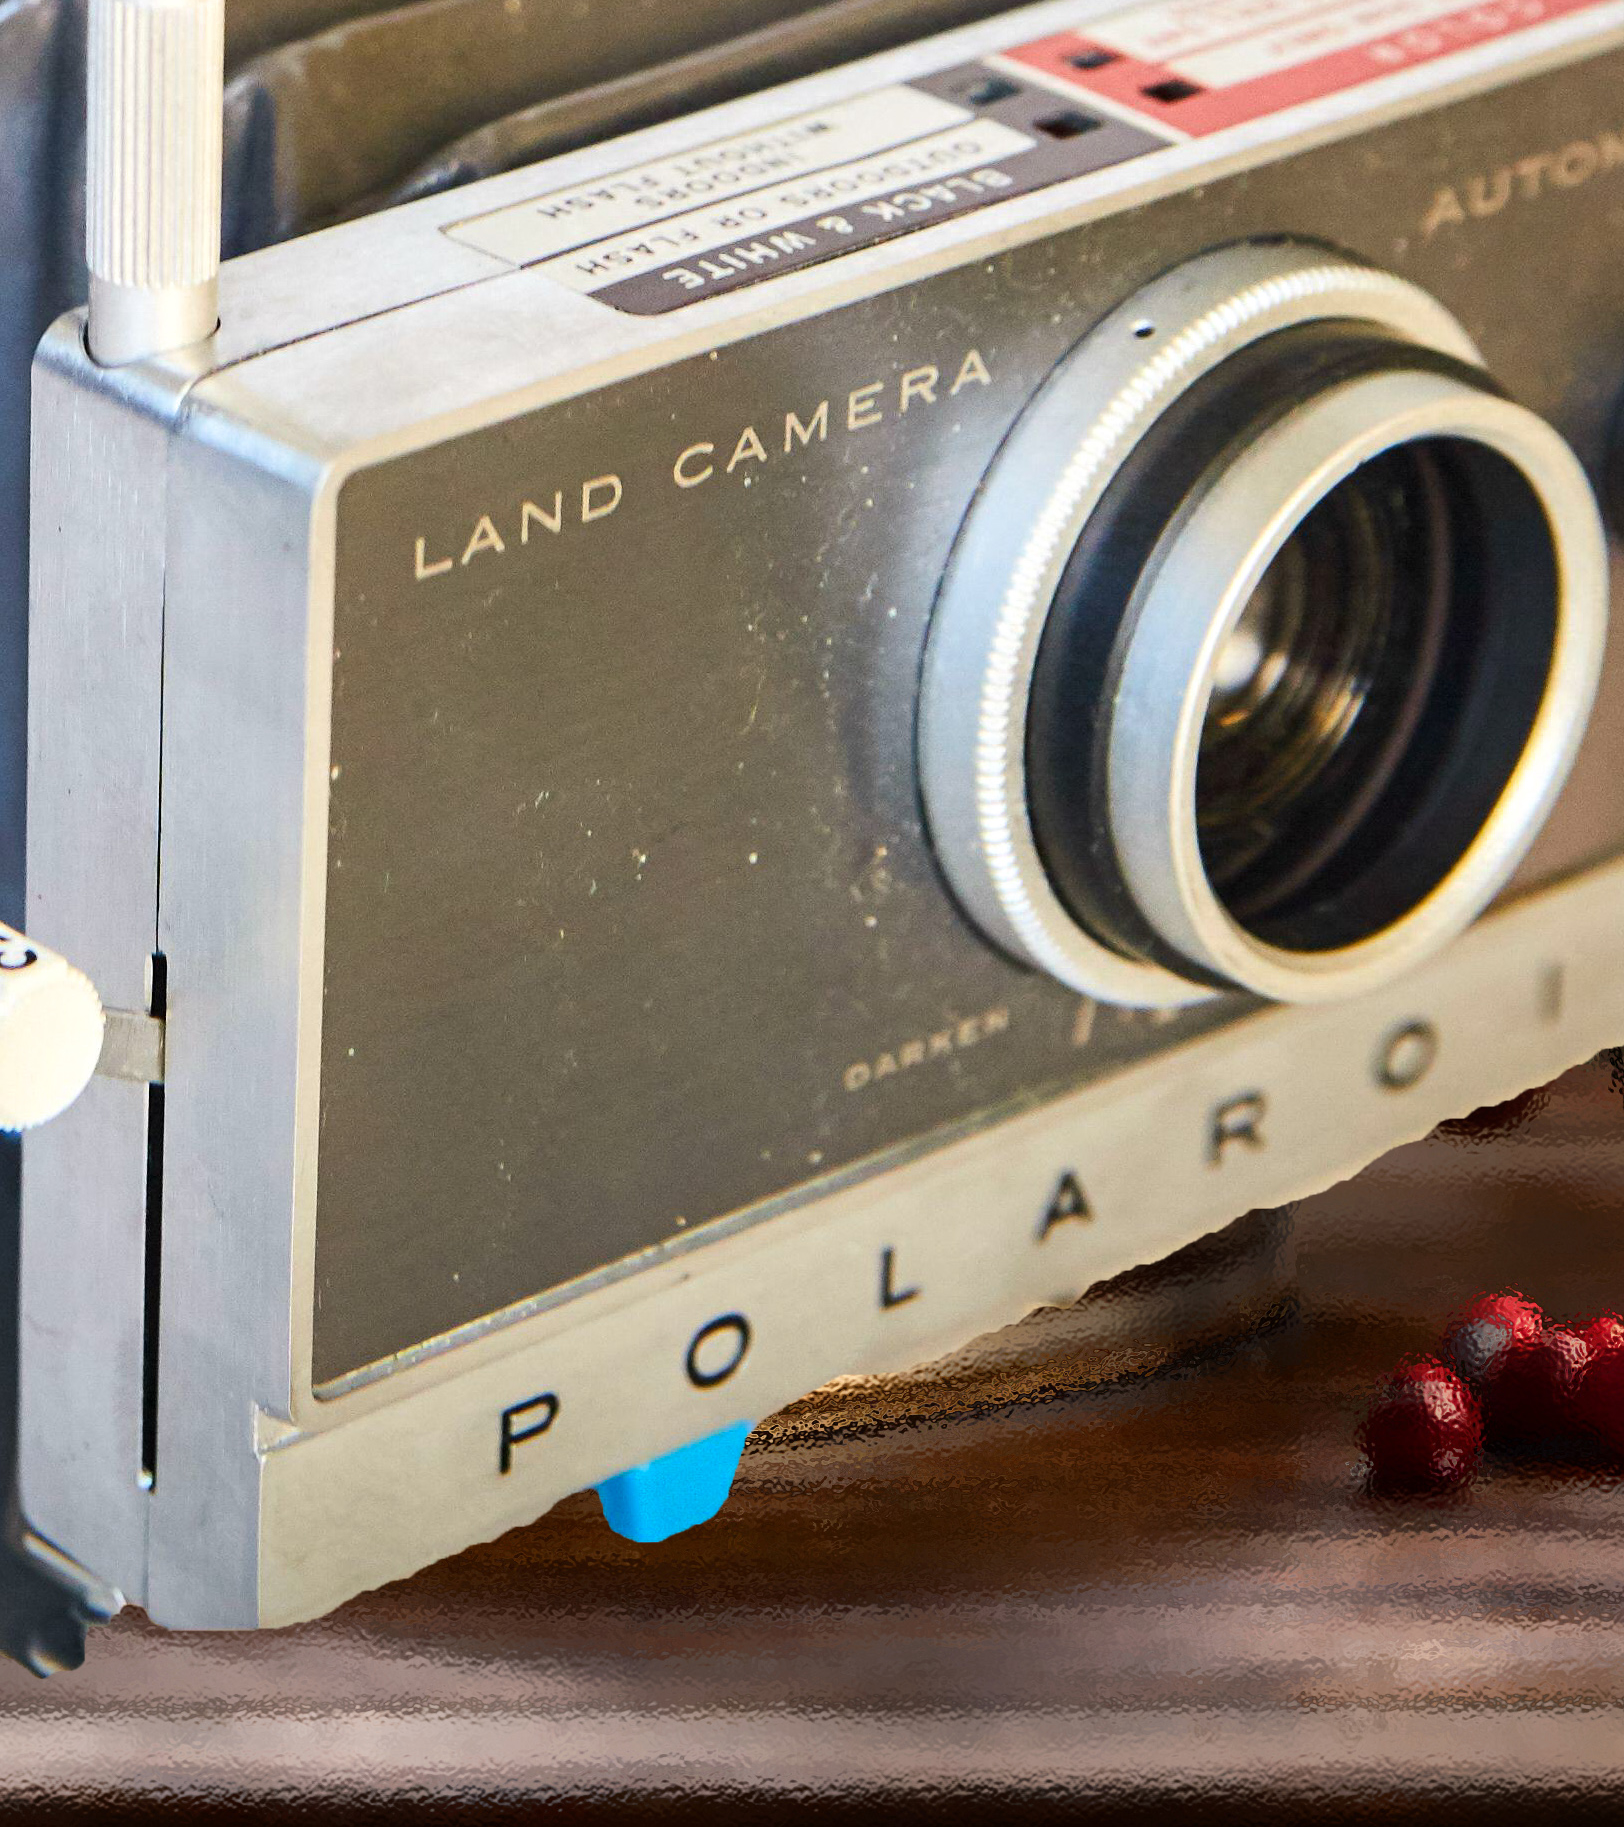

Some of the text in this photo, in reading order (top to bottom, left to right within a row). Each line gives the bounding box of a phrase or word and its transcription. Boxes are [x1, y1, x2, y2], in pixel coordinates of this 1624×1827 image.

[537, 122, 830, 220] WITHOUT FLASH
[575, 140, 981, 275] OUTDOORS OR FLASH
[635, 149, 806, 209] INDOORS
[661, 167, 1014, 290] BLACK & WHITE
[414, 349, 994, 581] LAND CAMERA
[843, 1006, 1009, 1091] DARKEN
